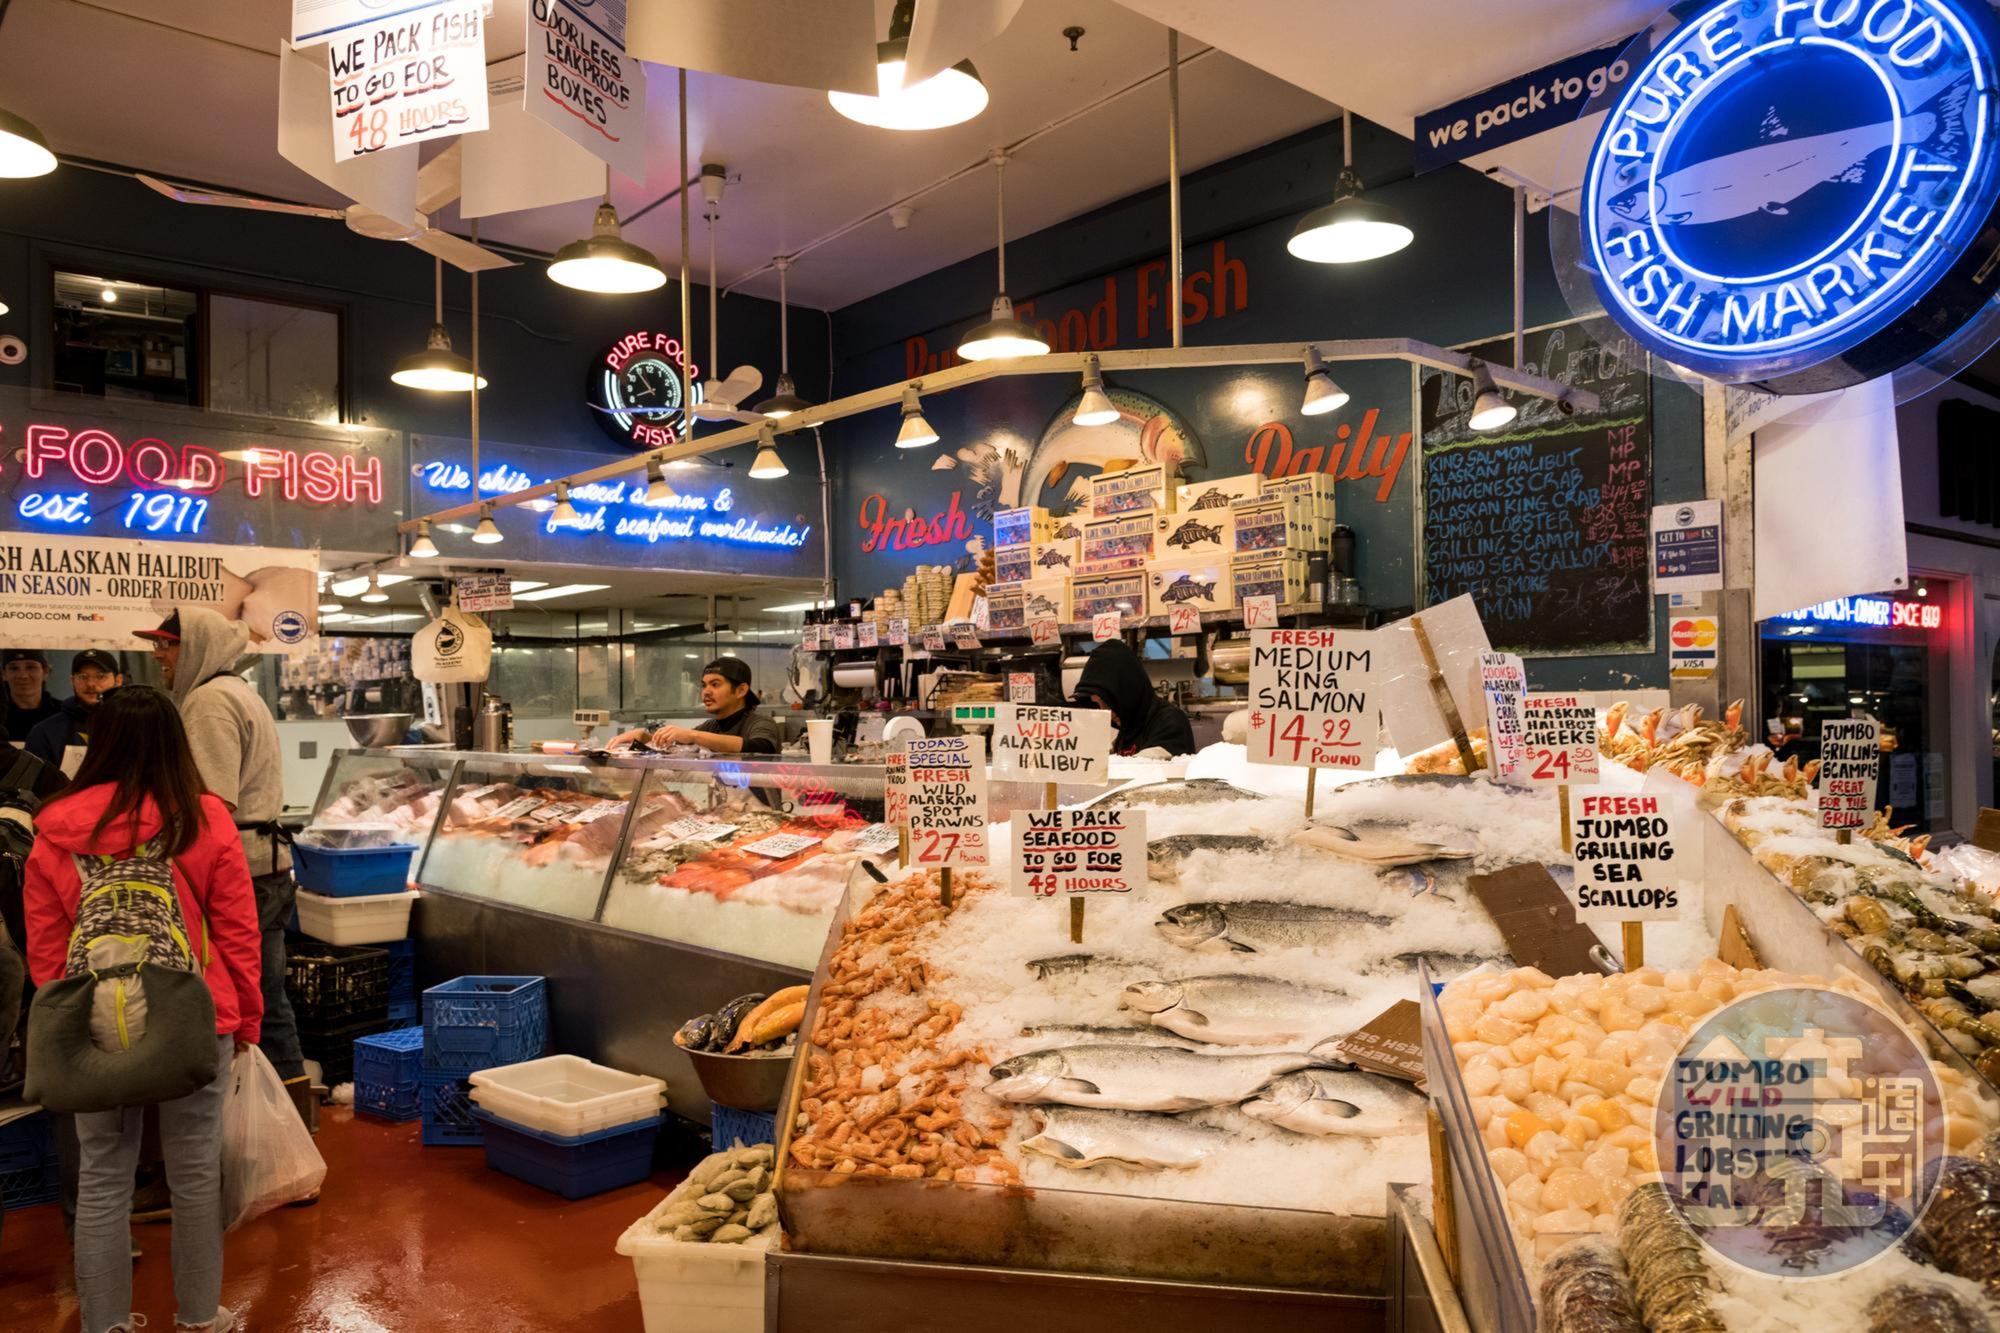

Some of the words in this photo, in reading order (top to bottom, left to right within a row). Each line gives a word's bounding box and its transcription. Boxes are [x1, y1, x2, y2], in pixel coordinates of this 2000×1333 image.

[331, 38, 365, 78] WE
[374, 21, 422, 64] PACK
[431, 9, 478, 42] FISH
[532, 0, 622, 79] ODORLESS
[546, 31, 630, 103] LEAKPROOF
[334, 83, 359, 107] TO
[366, 71, 395, 96] GO
[404, 55, 450, 87] FOR
[1609, 12, 1741, 160] PURE
[1776, 0, 1944, 66] FOOD
[548, 63, 607, 125] BOXES
[1429, 121, 1466, 149] we
[1476, 87, 1546, 134] pack
[1552, 75, 1583, 103] to
[1587, 58, 1629, 98] go
[349, 110, 388, 150] 48
[400, 99, 467, 131] HOURS
[1605, 227, 1699, 336] FISH
[1721, 149, 1958, 338] MARKET
[1137, 241, 1248, 338] Fish
[607, 331, 651, 370] PURE
[655, 334, 698, 378] FOOD
[633, 425, 676, 446] FISH
[26, 425, 225, 494] FOOD
[246, 448, 382, 503] FISH
[1245, 408, 1413, 504] Daily
[1429, 453, 1463, 473] KING
[1466, 445, 1532, 466] SALMON
[1429, 463, 1500, 487] ALASKAN
[1507, 448, 1582, 473] HALIBUT
[425, 462, 471, 489] We
[713, 487, 732, 513] &
[1429, 476, 1523, 507] DUNGENESS
[1528, 469, 1583, 491] CRAB
[1609, 461, 1641, 483] MP
[19, 492, 92, 523] est.
[125, 492, 208, 533] 1911
[1428, 502, 1500, 523] ALASKAN
[1505, 497, 1549, 514] KING
[615, 514, 694, 544] seafood
[700, 518, 810, 547] worldwide!
[860, 491, 973, 553] Fresh
[1426, 523, 1483, 540] JUMBO
[1491, 511, 1573, 534] LOBSTER
[1428, 538, 1505, 562] GRILLING
[1511, 531, 1580, 551] SCAMPI
[30, 548, 130, 575] ALASKAN
[137, 554, 223, 580] HALIBUT
[1428, 561, 1485, 582] JUMBO
[1489, 556, 1524, 575] SEA
[22, 575, 91, 597] SEASON
[107, 579, 163, 599] ORDER
[168, 581, 224, 601] TODAY!
[77, 613, 104, 621] FedEx
[1893, 602, 1919, 626] SINCE
[1271, 630, 1334, 647] FRESH
[1672, 630, 1715, 639] MasterCard
[1254, 647, 1371, 672] MEDIUM
[1483, 654, 1506, 665] WILD
[1278, 669, 1339, 690] KING
[1483, 667, 1517, 679] COOKED
[1483, 680, 1521, 692] ALASKAN
[1259, 688, 1366, 713] SALMON
[1494, 693, 1516, 705] KING
[1524, 698, 1577, 709] FRESH
[1016, 708, 1071, 722] FRESH
[1496, 706, 1517, 719] CRAB
[1525, 707, 1596, 719] ALASKAN
[1017, 723, 1070, 738] WILD
[1497, 720, 1521, 734] LEGS
[1823, 724, 1875, 740] JUMBO
[908, 739, 965, 751] TODAYS
[1000, 735, 1078, 750] ALASKAN
[1498, 736, 1513, 745] WE
[1524, 730, 1596, 746] CHEEKS
[909, 753, 970, 764] SPECIAL
[1311, 746, 1361, 766] POUND
[1823, 744, 1879, 760] GRILLING
[1019, 754, 1094, 772] HALIBUT
[1823, 762, 1877, 780] SCAMPIS
[913, 769, 970, 782] FRESH
[923, 784, 965, 795] WILD
[1829, 781, 1864, 793] GREAT
[909, 794, 976, 805] ALASKAN
[1583, 796, 1658, 817] FRESH
[1820, 797, 1840, 808] FOR
[1847, 797, 1867, 808] THE
[911, 815, 984, 828] PRAWNS
[923, 806, 963, 817] SPOT
[1028, 811, 1062, 828] WE
[1072, 810, 1121, 826] PACK
[1823, 812, 1864, 826] GRILL
[1576, 816, 1668, 839] JUMBO
[1023, 831, 1116, 846] SEAFOOD
[1023, 852, 1045, 866] TO
[1053, 852, 1076, 866] GO
[1087, 852, 1122, 866] FOR
[1575, 841, 1674, 861] GRILLING
[1593, 863, 1643, 882] SEA
[1028, 874, 1057, 897] 48
[1065, 877, 1128, 891] HOURS
[1677, 1060, 1810, 1085] JUMBO
[1687, 1087, 1783, 1107] WILD
[1676, 1110, 1813, 1140] GRILLING
